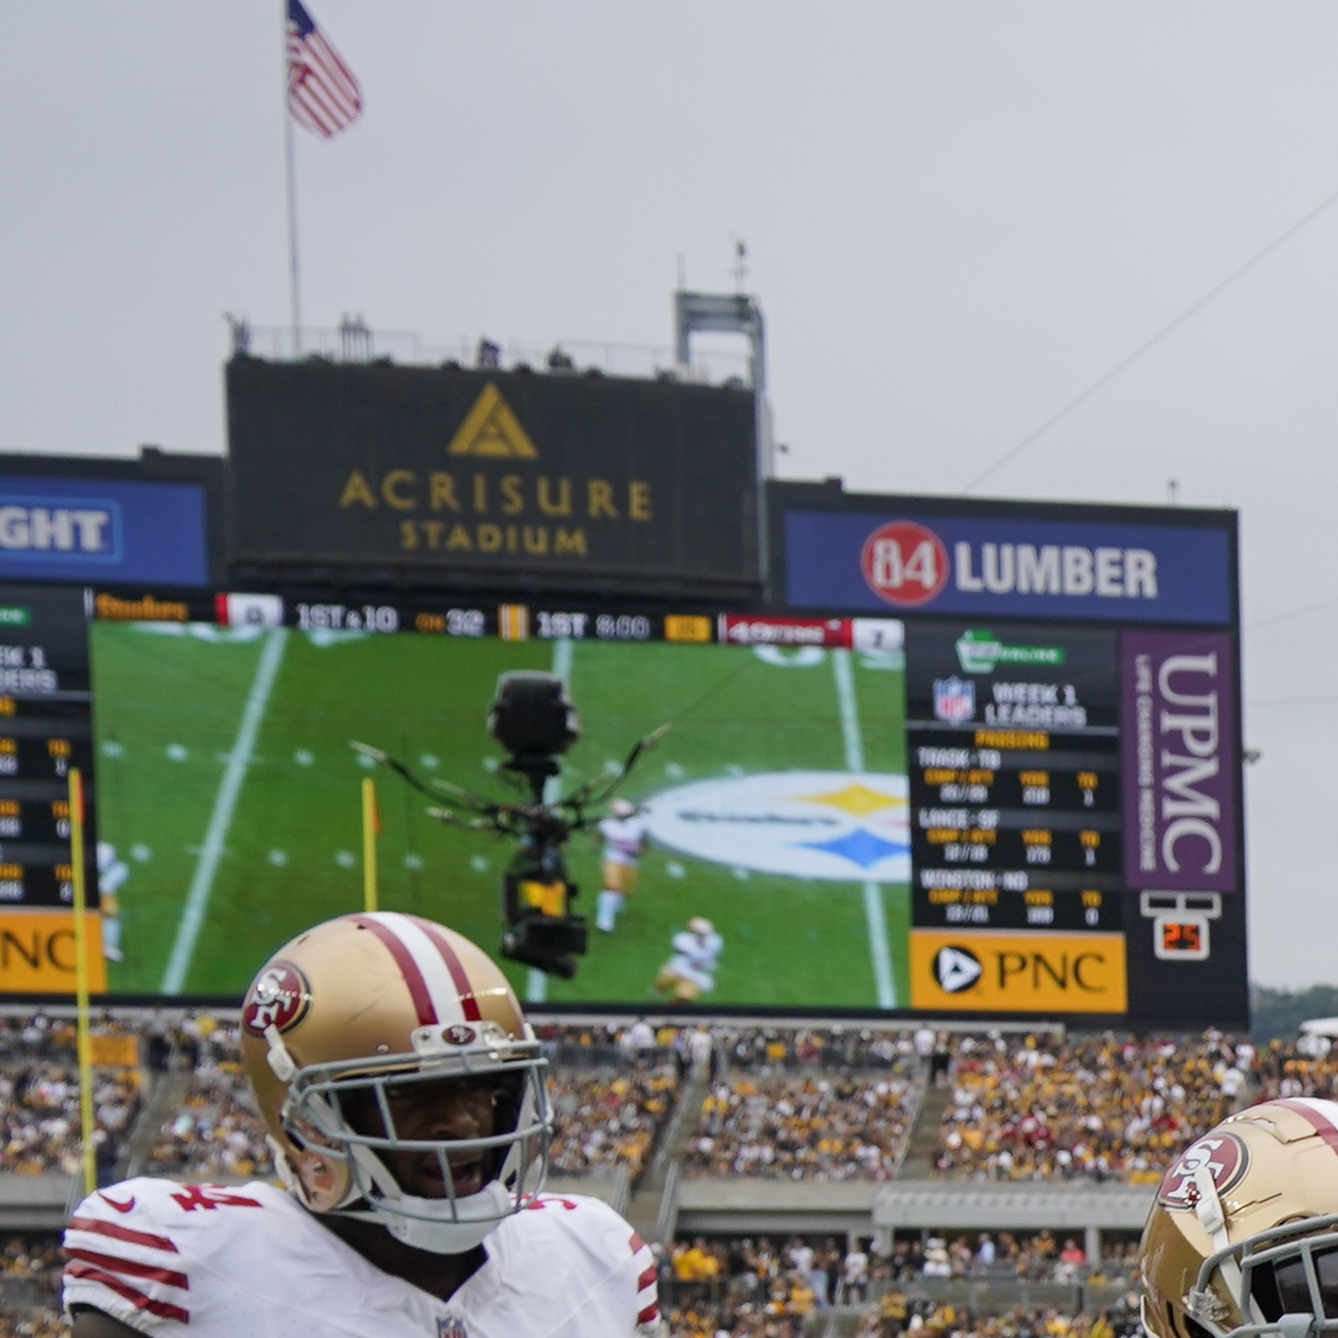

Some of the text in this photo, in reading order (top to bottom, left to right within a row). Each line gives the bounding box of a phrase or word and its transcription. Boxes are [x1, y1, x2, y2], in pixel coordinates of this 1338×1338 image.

[339, 469, 652, 522] ACRISURE
[401, 519, 588, 557] STADIUM
[872, 537, 1158, 599] 84 LUMBER
[297, 603, 345, 630] 1ST
[363, 604, 399, 632] 10
[536, 611, 588, 639] 1ST
[993, 681, 1058, 704] WEEK
[985, 703, 1087, 727] LEADERS
[1135, 654, 1157, 873] LIFE CHANGING MEDICINE
[1158, 652, 1223, 876] UPMC
[998, 951, 1106, 993] PNC
